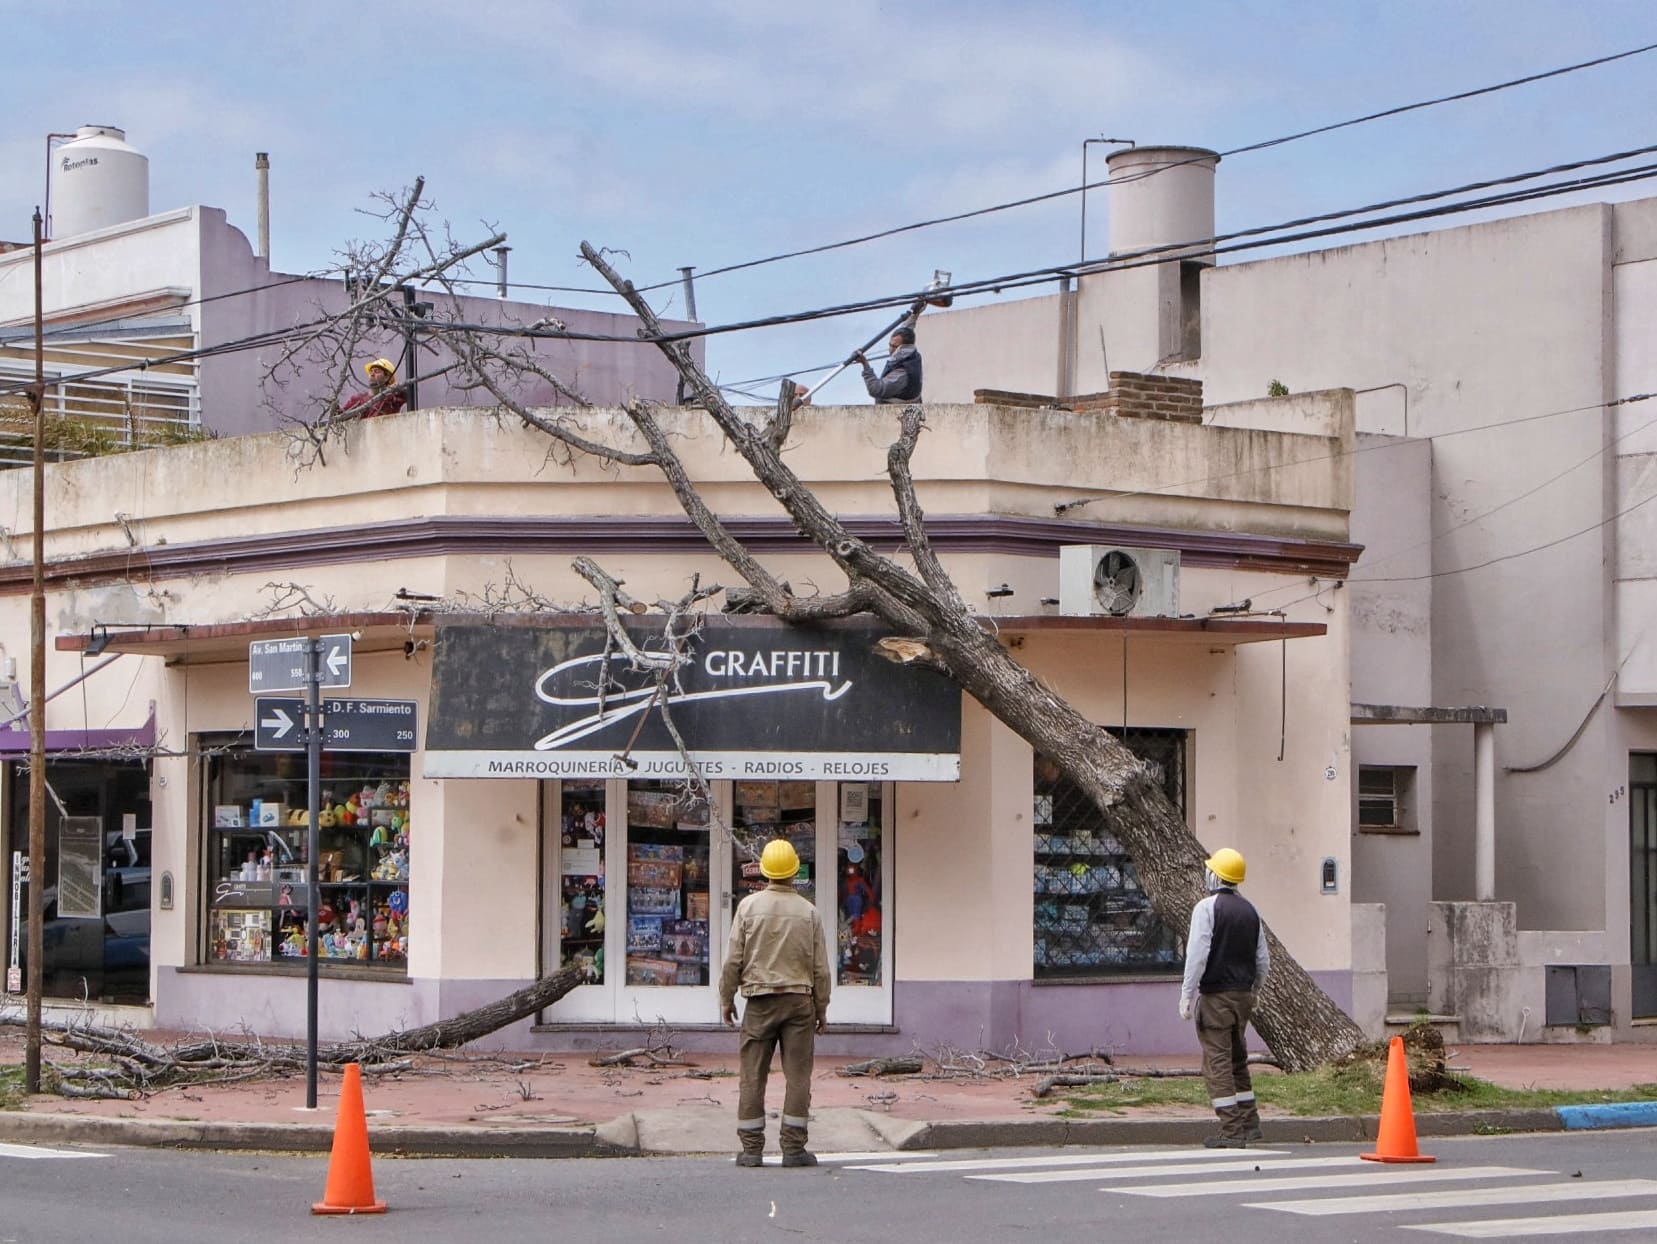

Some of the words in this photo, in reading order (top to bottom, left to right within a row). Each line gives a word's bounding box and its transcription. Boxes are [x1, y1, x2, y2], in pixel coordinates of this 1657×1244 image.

[264, 644, 278, 654] San
[705, 650, 840, 676] GRAFFITI
[360, 703, 411, 714] Sarmiento
[333, 729, 350, 739] 300
[396, 731, 413, 740] 250
[744, 761, 803, 774] RADIOS
[823, 762, 889, 775] RELOJES
